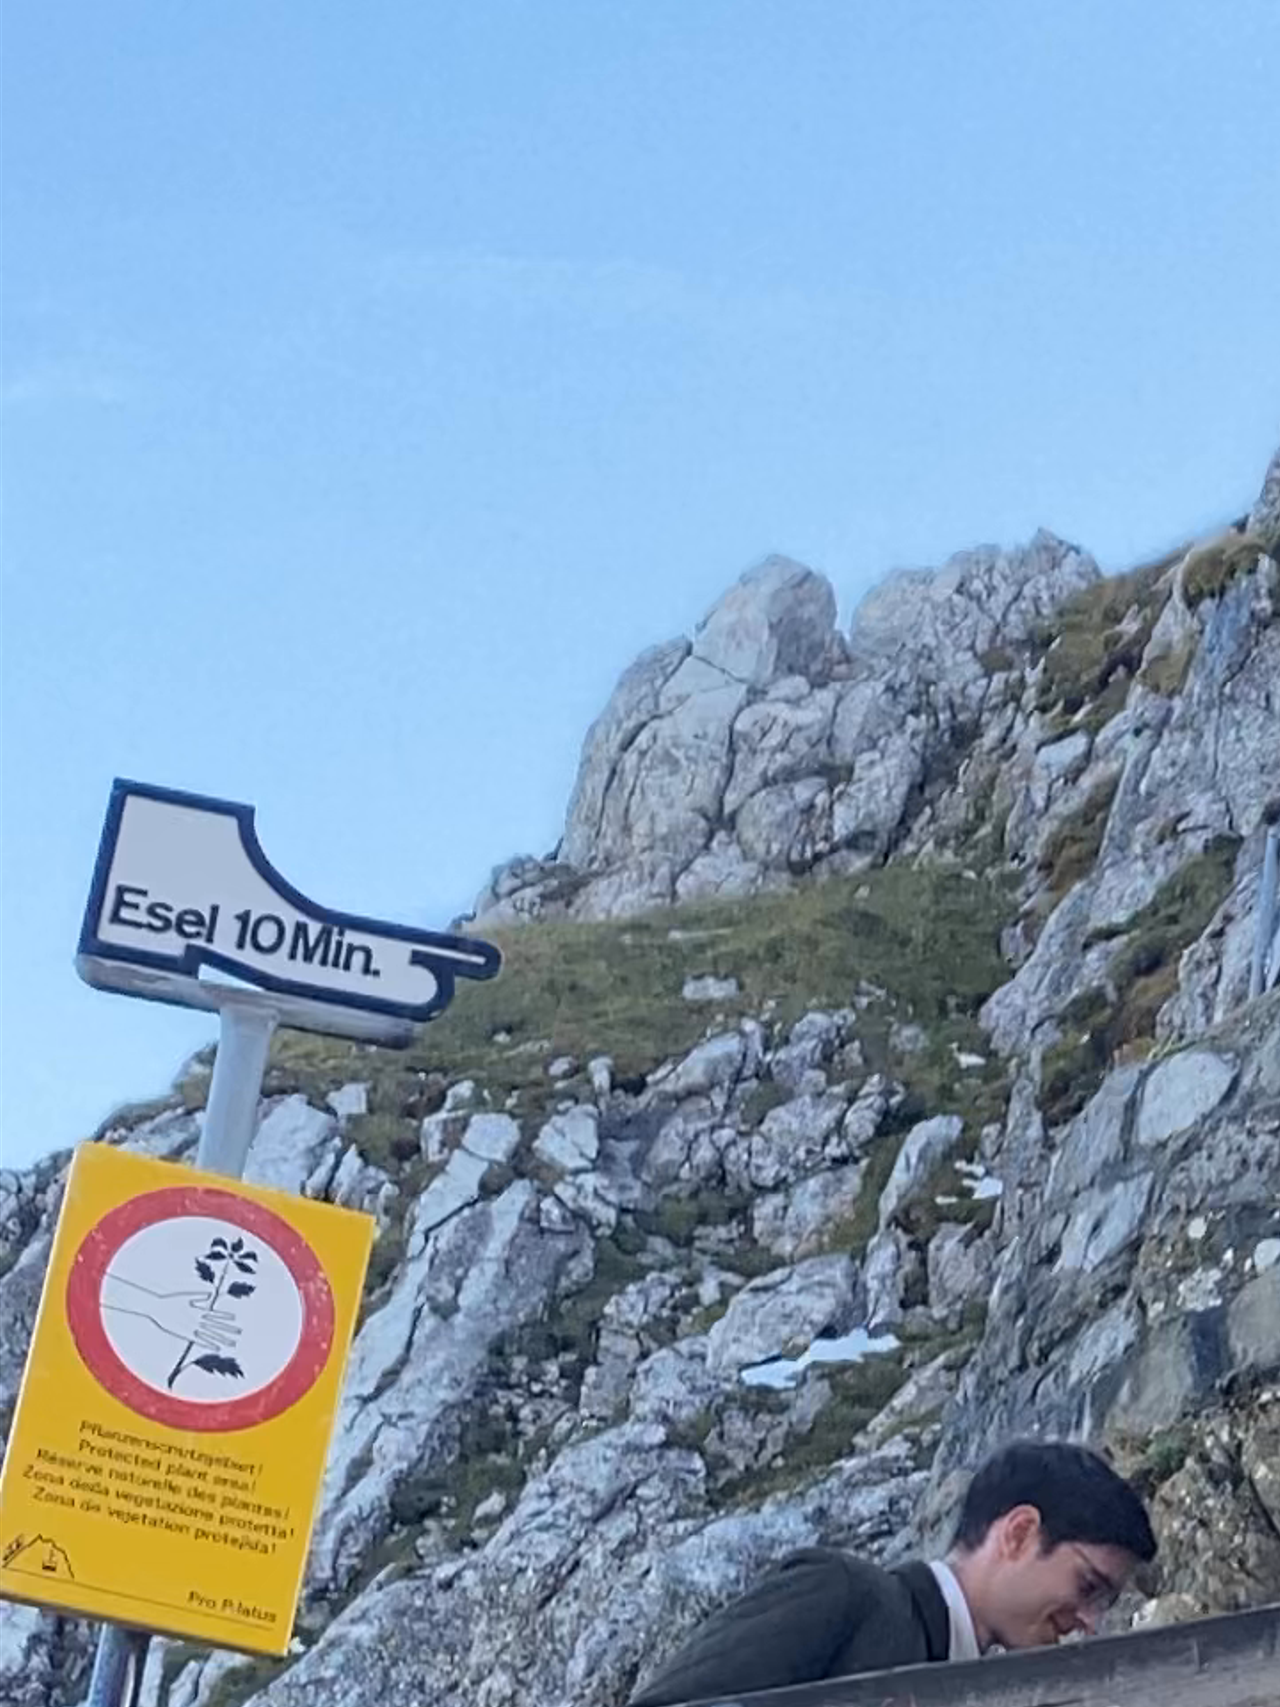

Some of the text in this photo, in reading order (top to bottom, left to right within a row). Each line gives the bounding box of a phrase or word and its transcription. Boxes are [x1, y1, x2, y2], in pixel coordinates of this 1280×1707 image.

[109, 884, 220, 944] Esel
[79, 1439, 161, 1470] Protected
[166, 1460, 208, 1482] plant
[22, 1464, 64, 1487] Zona
[116, 1489, 214, 1522] vegetazione
[33, 1486, 75, 1509] Zona
[187, 1483, 216, 1504] des
[187, 1590, 277, 1624] Pro Pilatus
